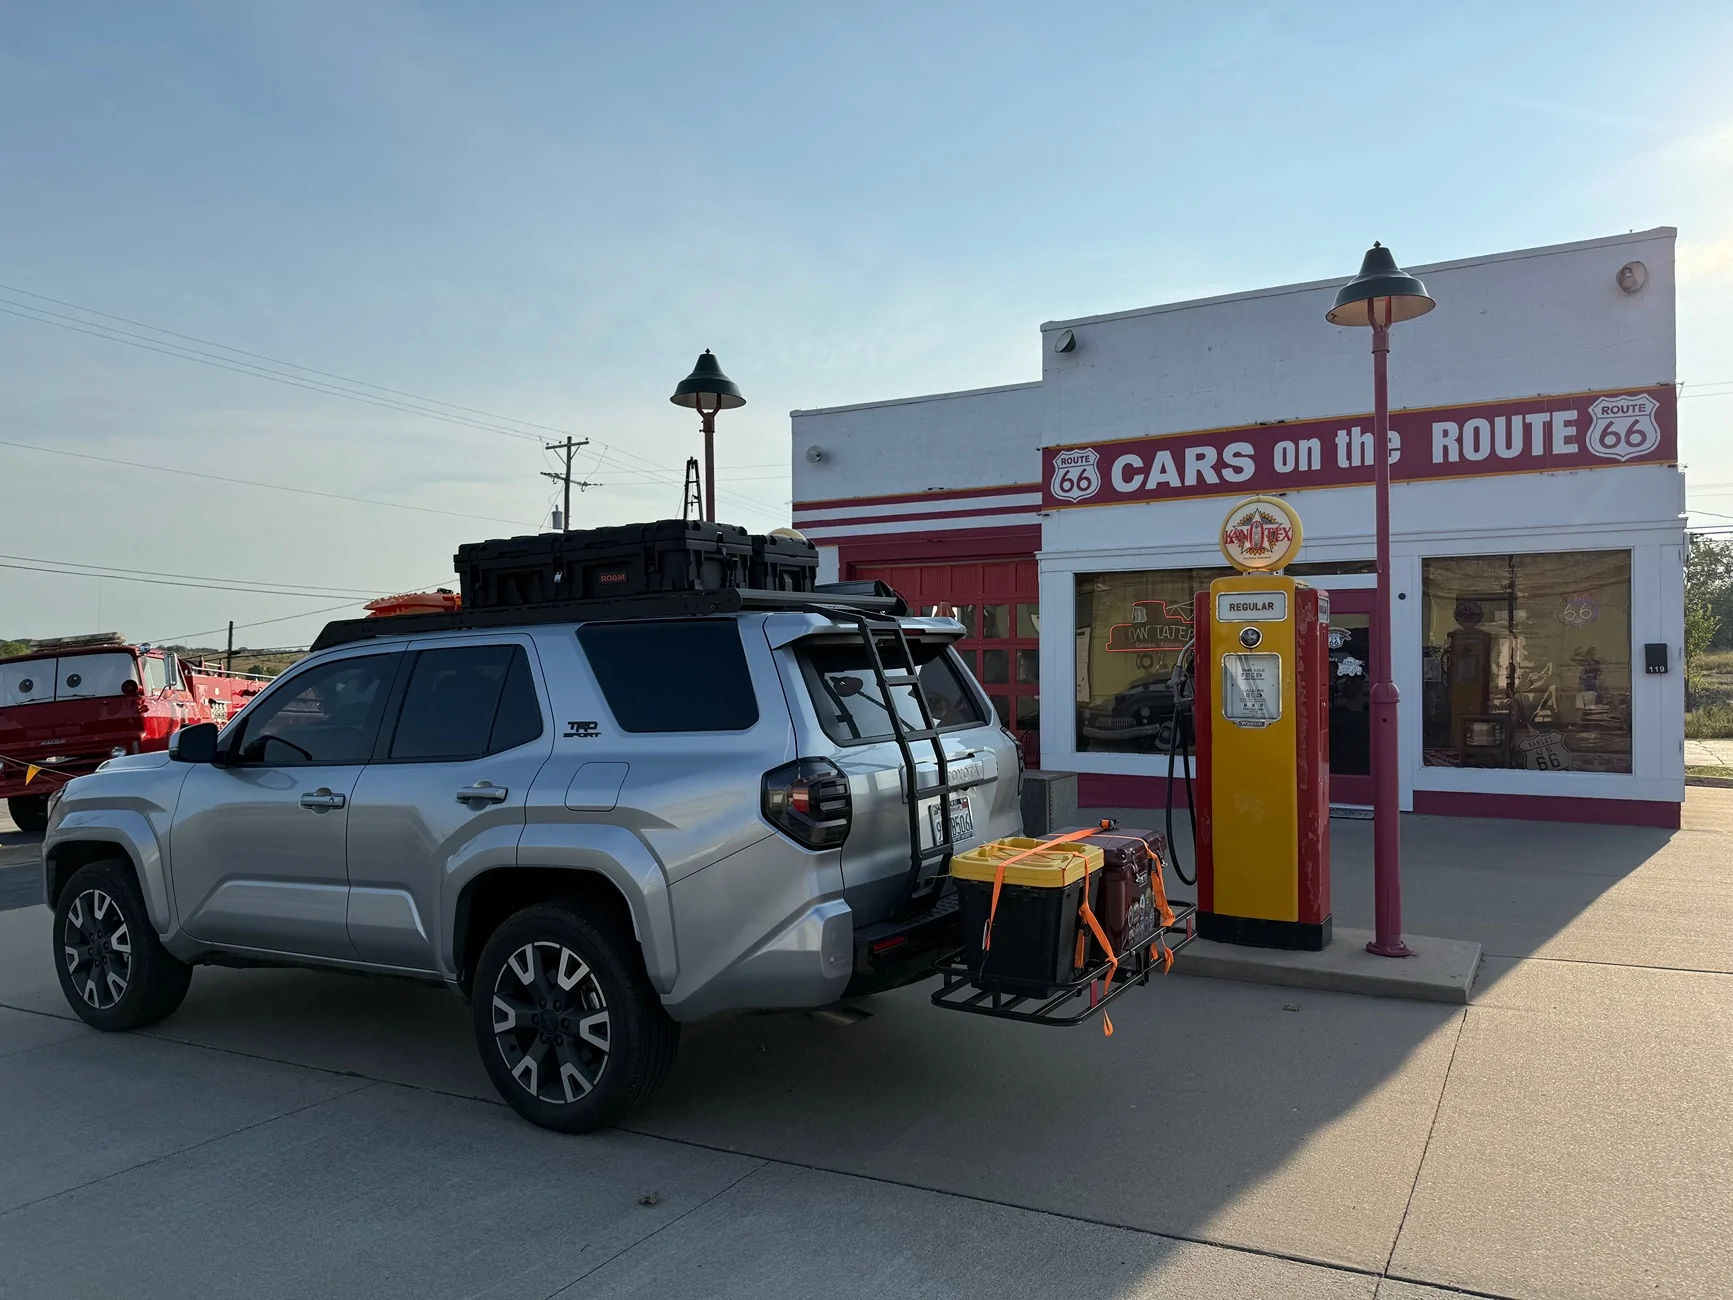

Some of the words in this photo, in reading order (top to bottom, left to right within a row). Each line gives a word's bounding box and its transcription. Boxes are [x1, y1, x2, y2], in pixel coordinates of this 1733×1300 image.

[1601, 403, 1646, 415] ROUTE
[1599, 419, 1647, 449] 66
[1111, 442, 1255, 492] CARS
[1273, 438, 1321, 473] on
[1432, 410, 1578, 463] ROUTE
[1061, 455, 1090, 466] ROUTE
[1059, 468, 1092, 493] 66
[601, 574, 625, 582] ROAM
[1229, 602, 1274, 612] REGULAR
[1564, 602, 1592, 620] 66
[568, 721, 598, 732] TRD
[1536, 752, 1561, 770] 66
